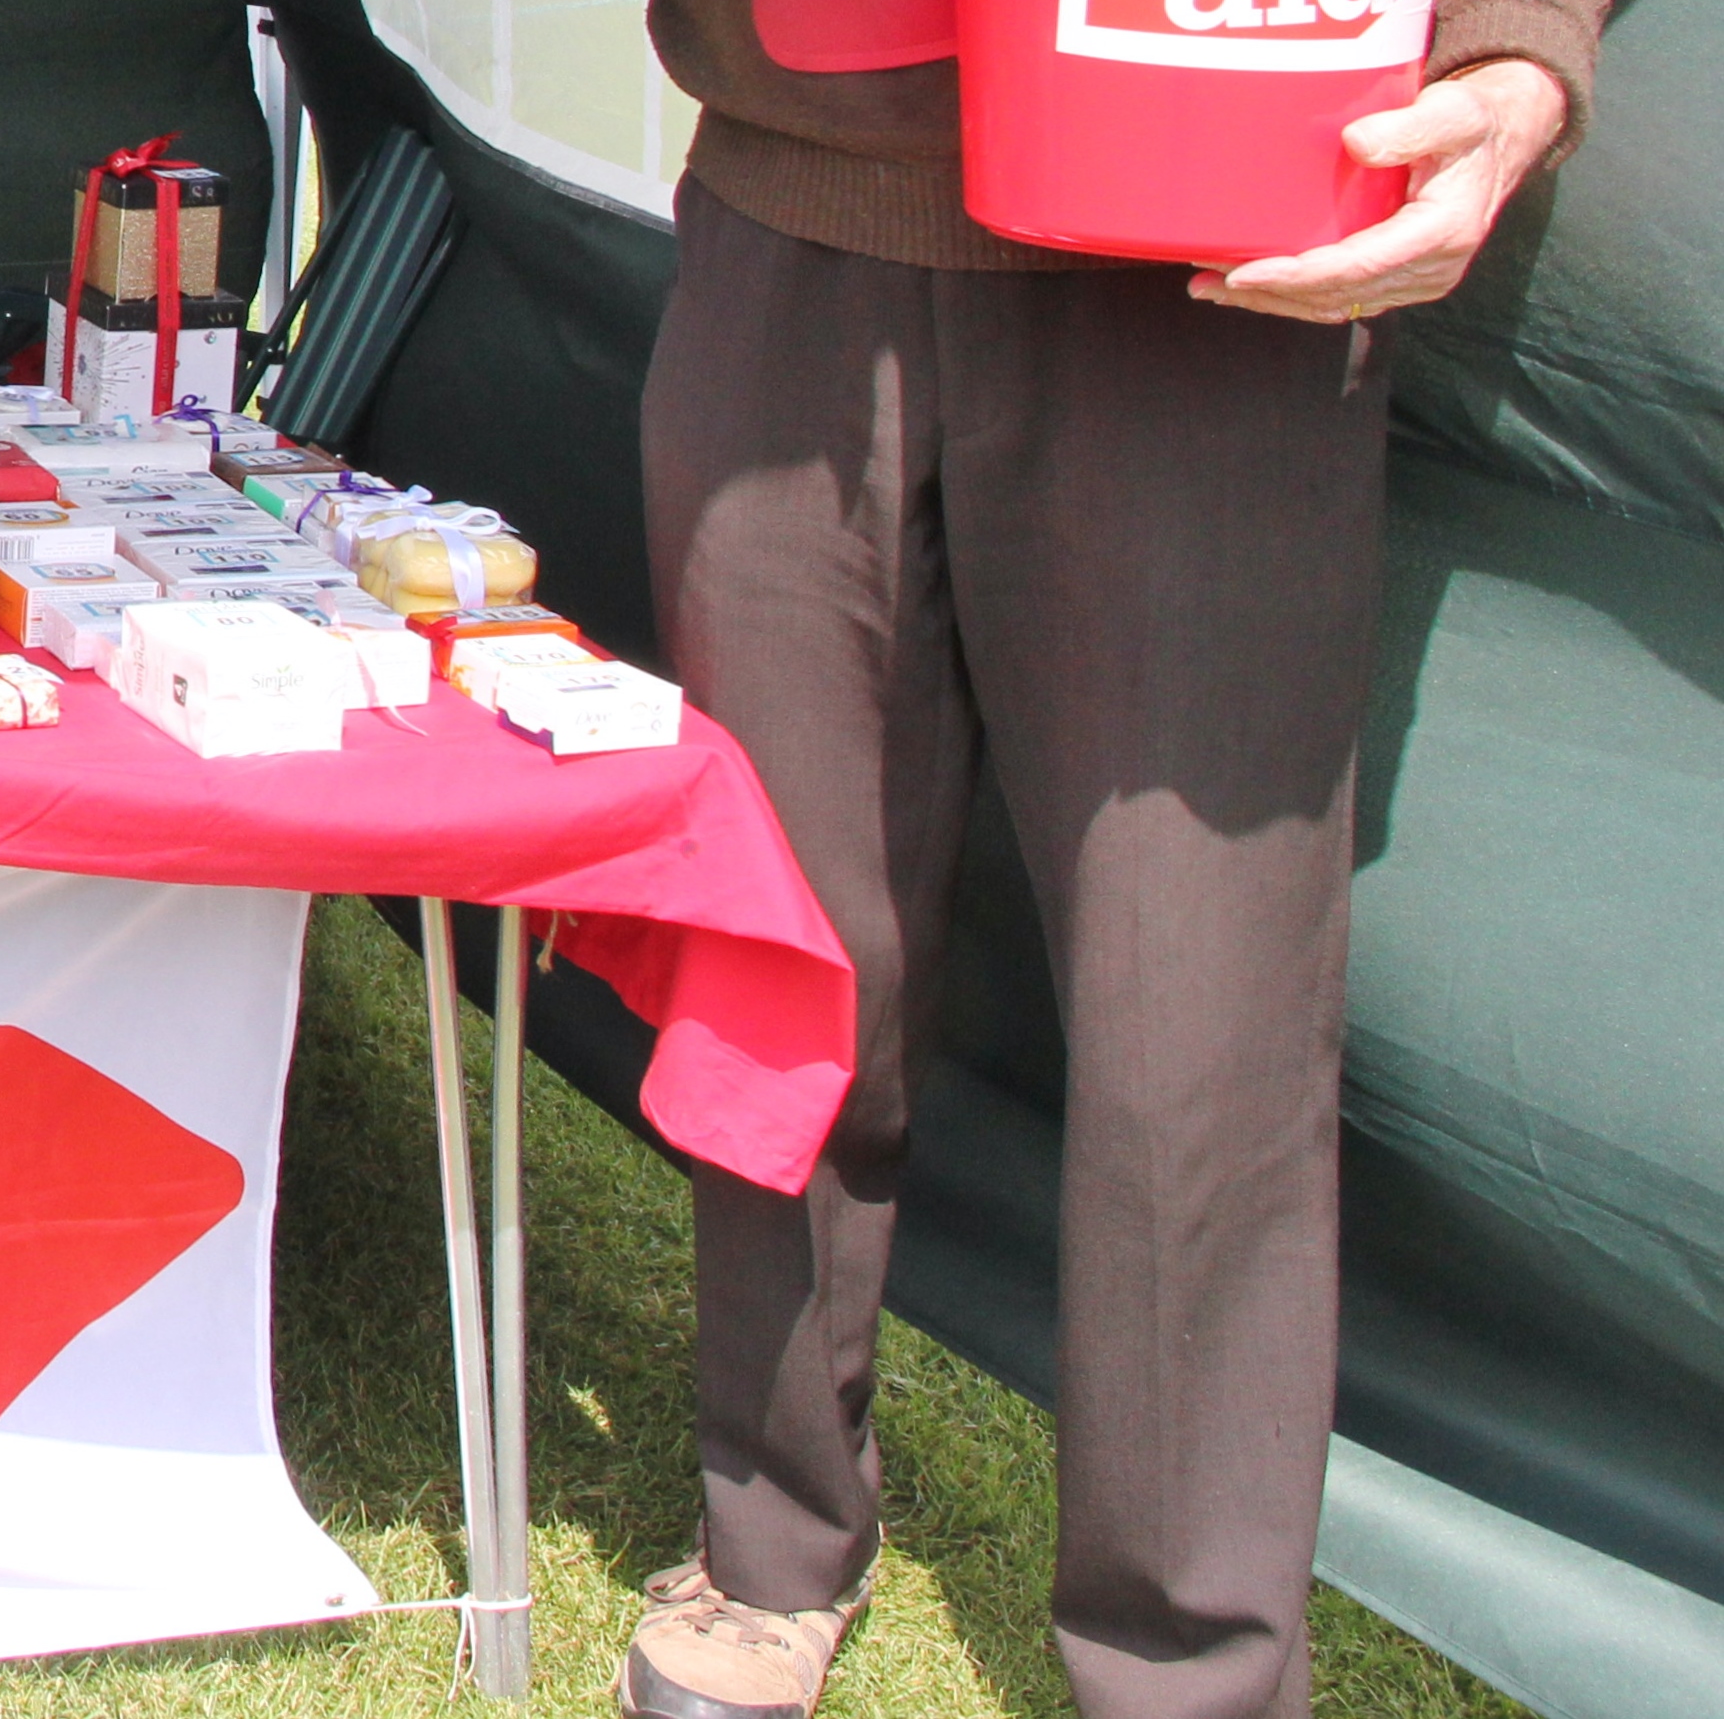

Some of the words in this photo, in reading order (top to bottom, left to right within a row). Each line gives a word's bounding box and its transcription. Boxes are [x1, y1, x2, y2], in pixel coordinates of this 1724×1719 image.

[247, 454, 293, 465] 135
[87, 477, 138, 488] Dove
[3, 511, 40, 521] 60
[124, 509, 182, 520] Dove
[174, 544, 233, 556] Dove
[213, 553, 267, 563] 110
[55, 566, 93, 577] 65
[512, 652, 567, 662] 170
[133, 633, 147, 699] Simple
[250, 671, 306, 693] Simple
[566, 674, 622, 685] 175
